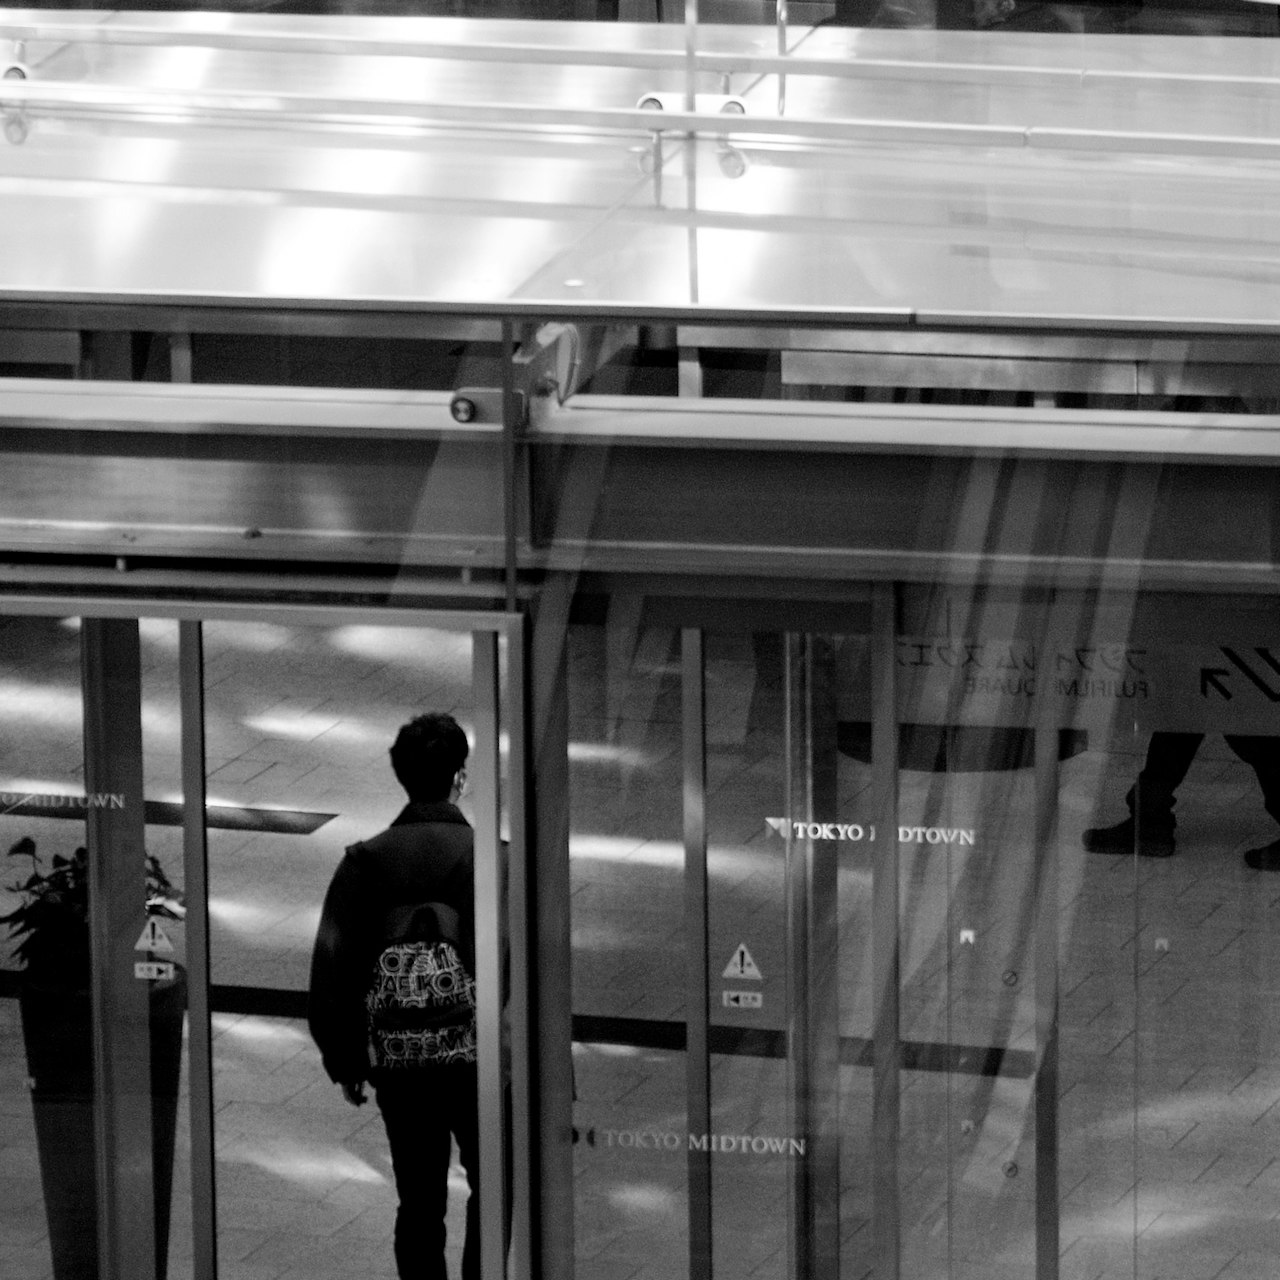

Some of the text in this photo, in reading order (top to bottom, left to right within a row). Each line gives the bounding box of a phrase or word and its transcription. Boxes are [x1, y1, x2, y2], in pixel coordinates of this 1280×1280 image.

[27, 793, 125, 809] MIDTOWN
[793, 822, 974, 845] TOKYO DTOWN
[605, 1129, 806, 1155] TOKYO MIDTOWN
